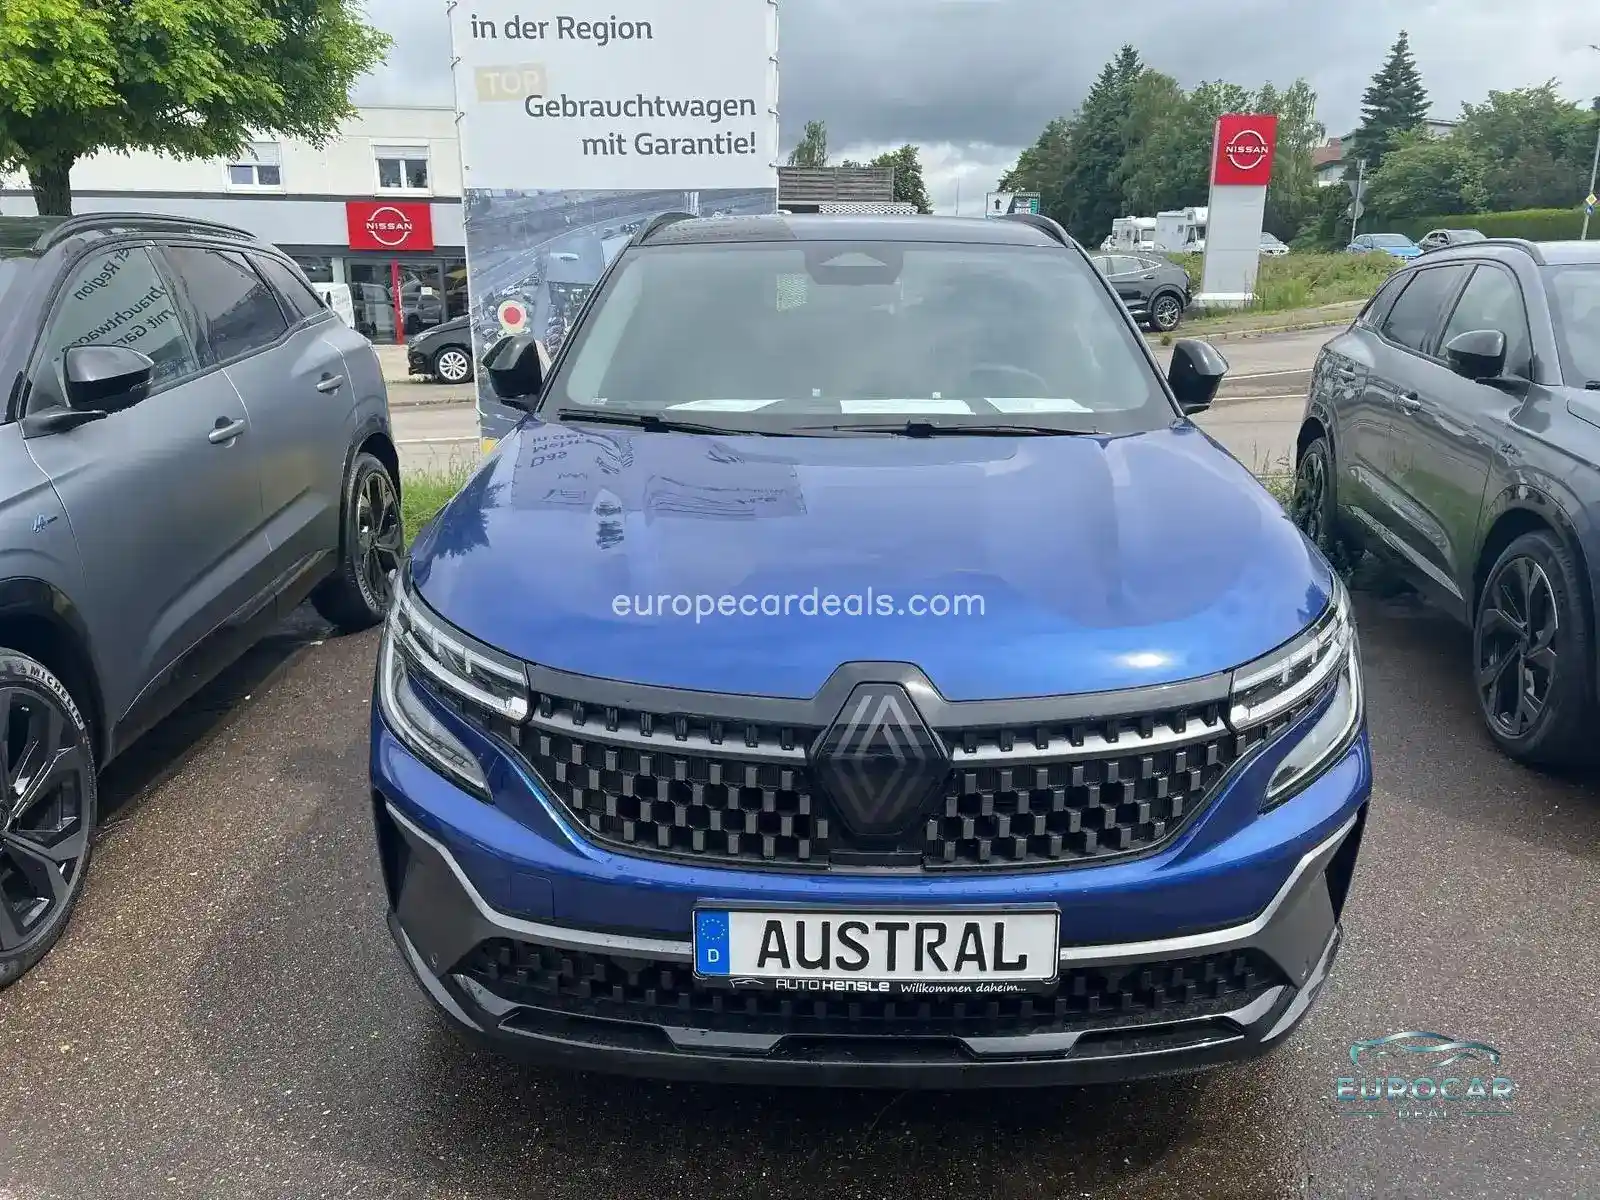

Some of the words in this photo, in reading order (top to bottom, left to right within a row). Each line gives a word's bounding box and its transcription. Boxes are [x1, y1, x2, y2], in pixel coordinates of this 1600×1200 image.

[471, 14, 497, 39] in
[504, 15, 549, 40] der
[556, 15, 653, 46] Region
[484, 70, 540, 95] TOP
[524, 94, 756, 123] Gebrauchtwagen
[582, 132, 627, 156] mit
[634, 131, 756, 156] Garantie!
[366, 222, 412, 230] NISSAN
[30, 665, 82, 724] MICHELIN
[707, 948, 721, 963] D
[757, 919, 1028, 972] AUSTRAL
[775, 979, 819, 990] AUTO
[900, 983, 972, 994] Willkommen
[976, 982, 1027, 993] daheim...
